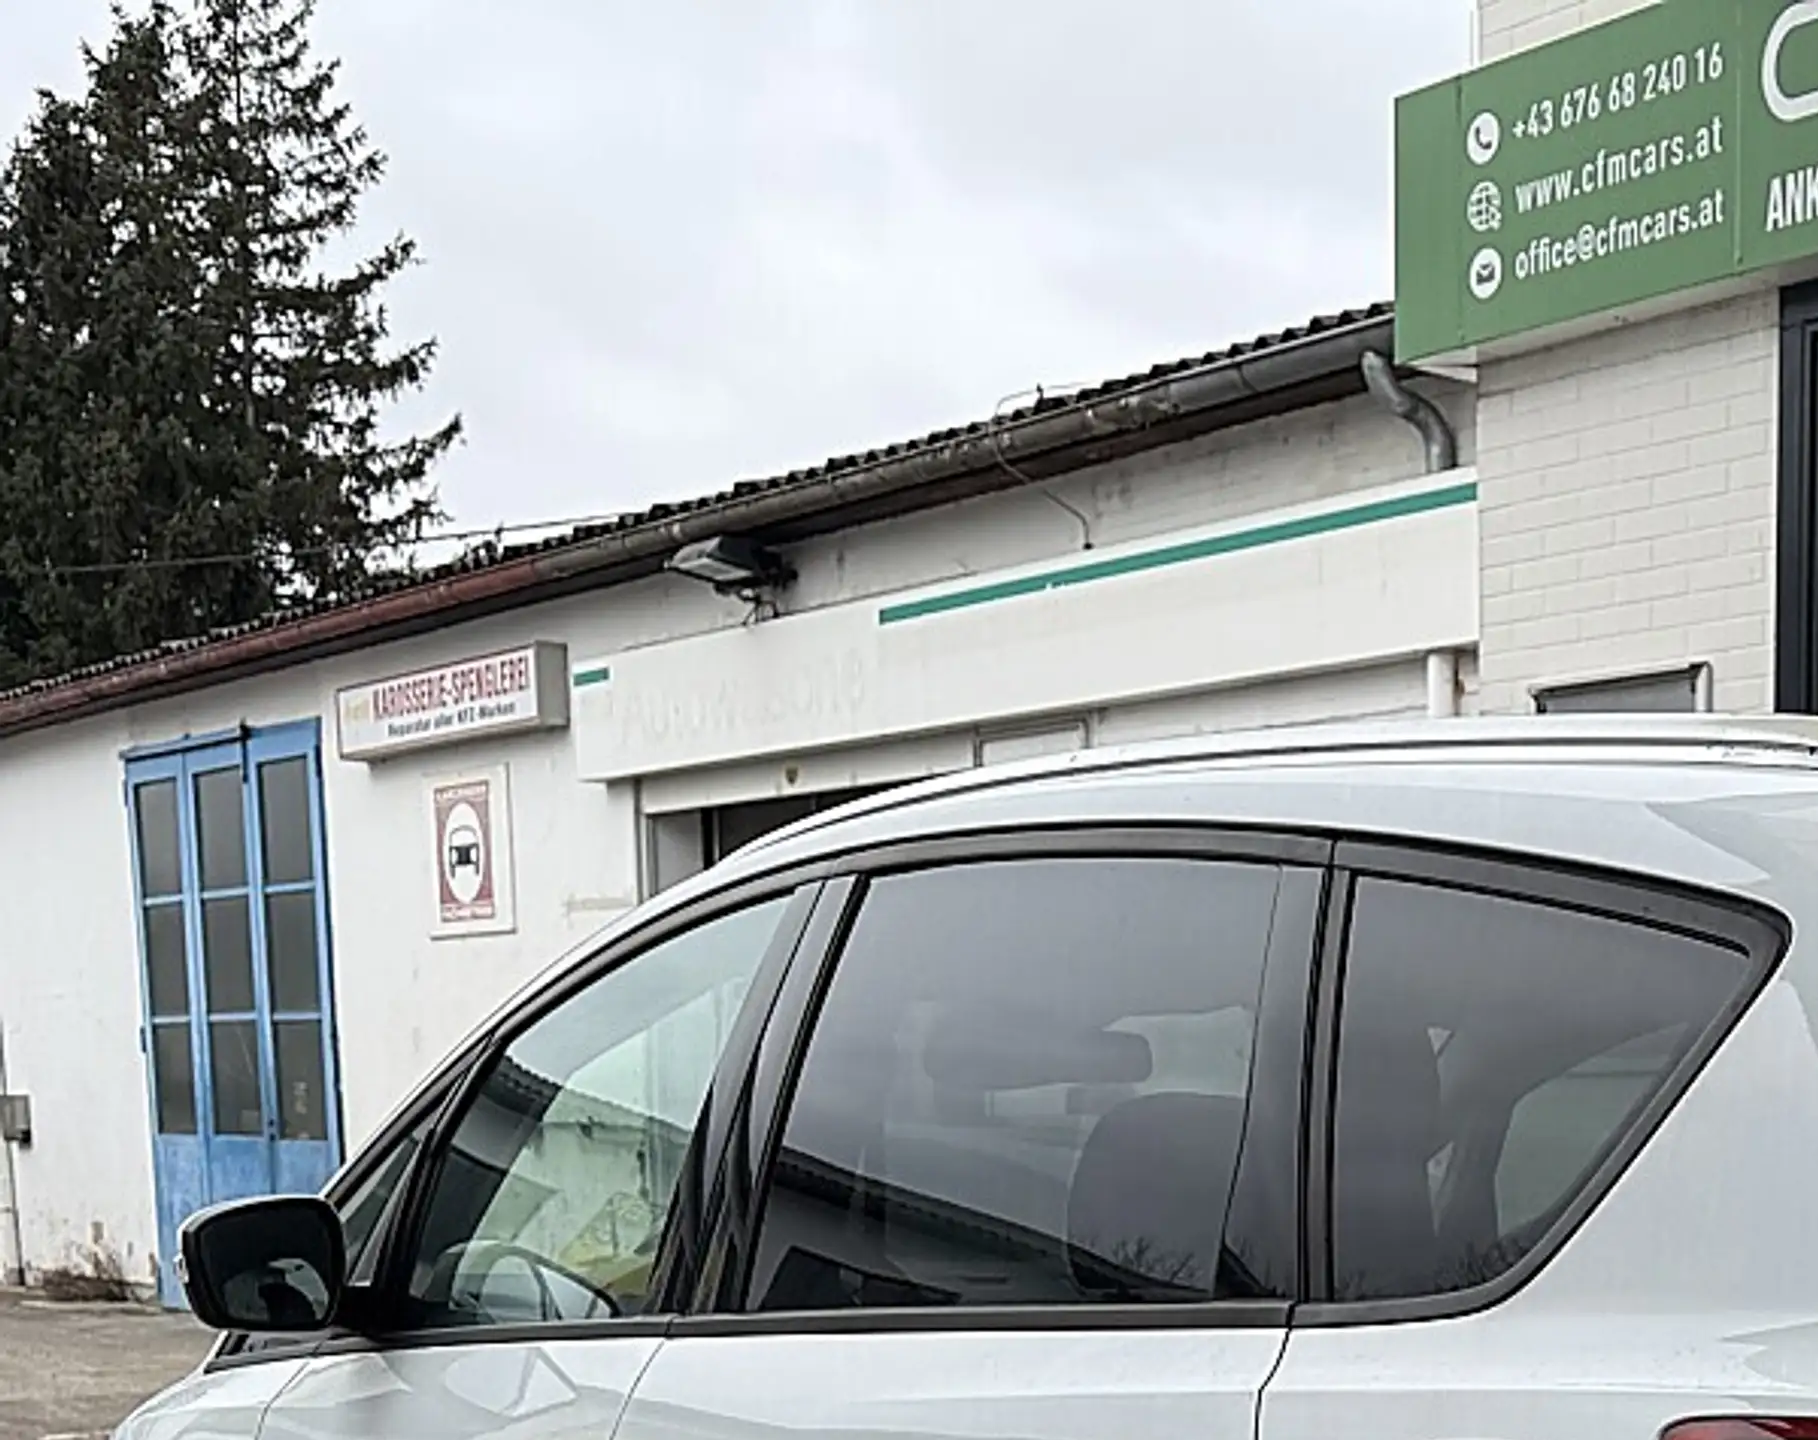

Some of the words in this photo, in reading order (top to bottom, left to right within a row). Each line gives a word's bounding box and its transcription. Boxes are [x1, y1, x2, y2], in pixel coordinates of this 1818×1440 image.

[1512, 100, 1554, 138] +43
[1560, 83, 1601, 128] 676
[1608, 72, 1636, 112] 68
[1642, 54, 1687, 101] 240
[1694, 42, 1723, 84] 16
[1514, 115, 1723, 214] www.cfmcars.at
[1514, 188, 1724, 280] office@cfmcars.at
